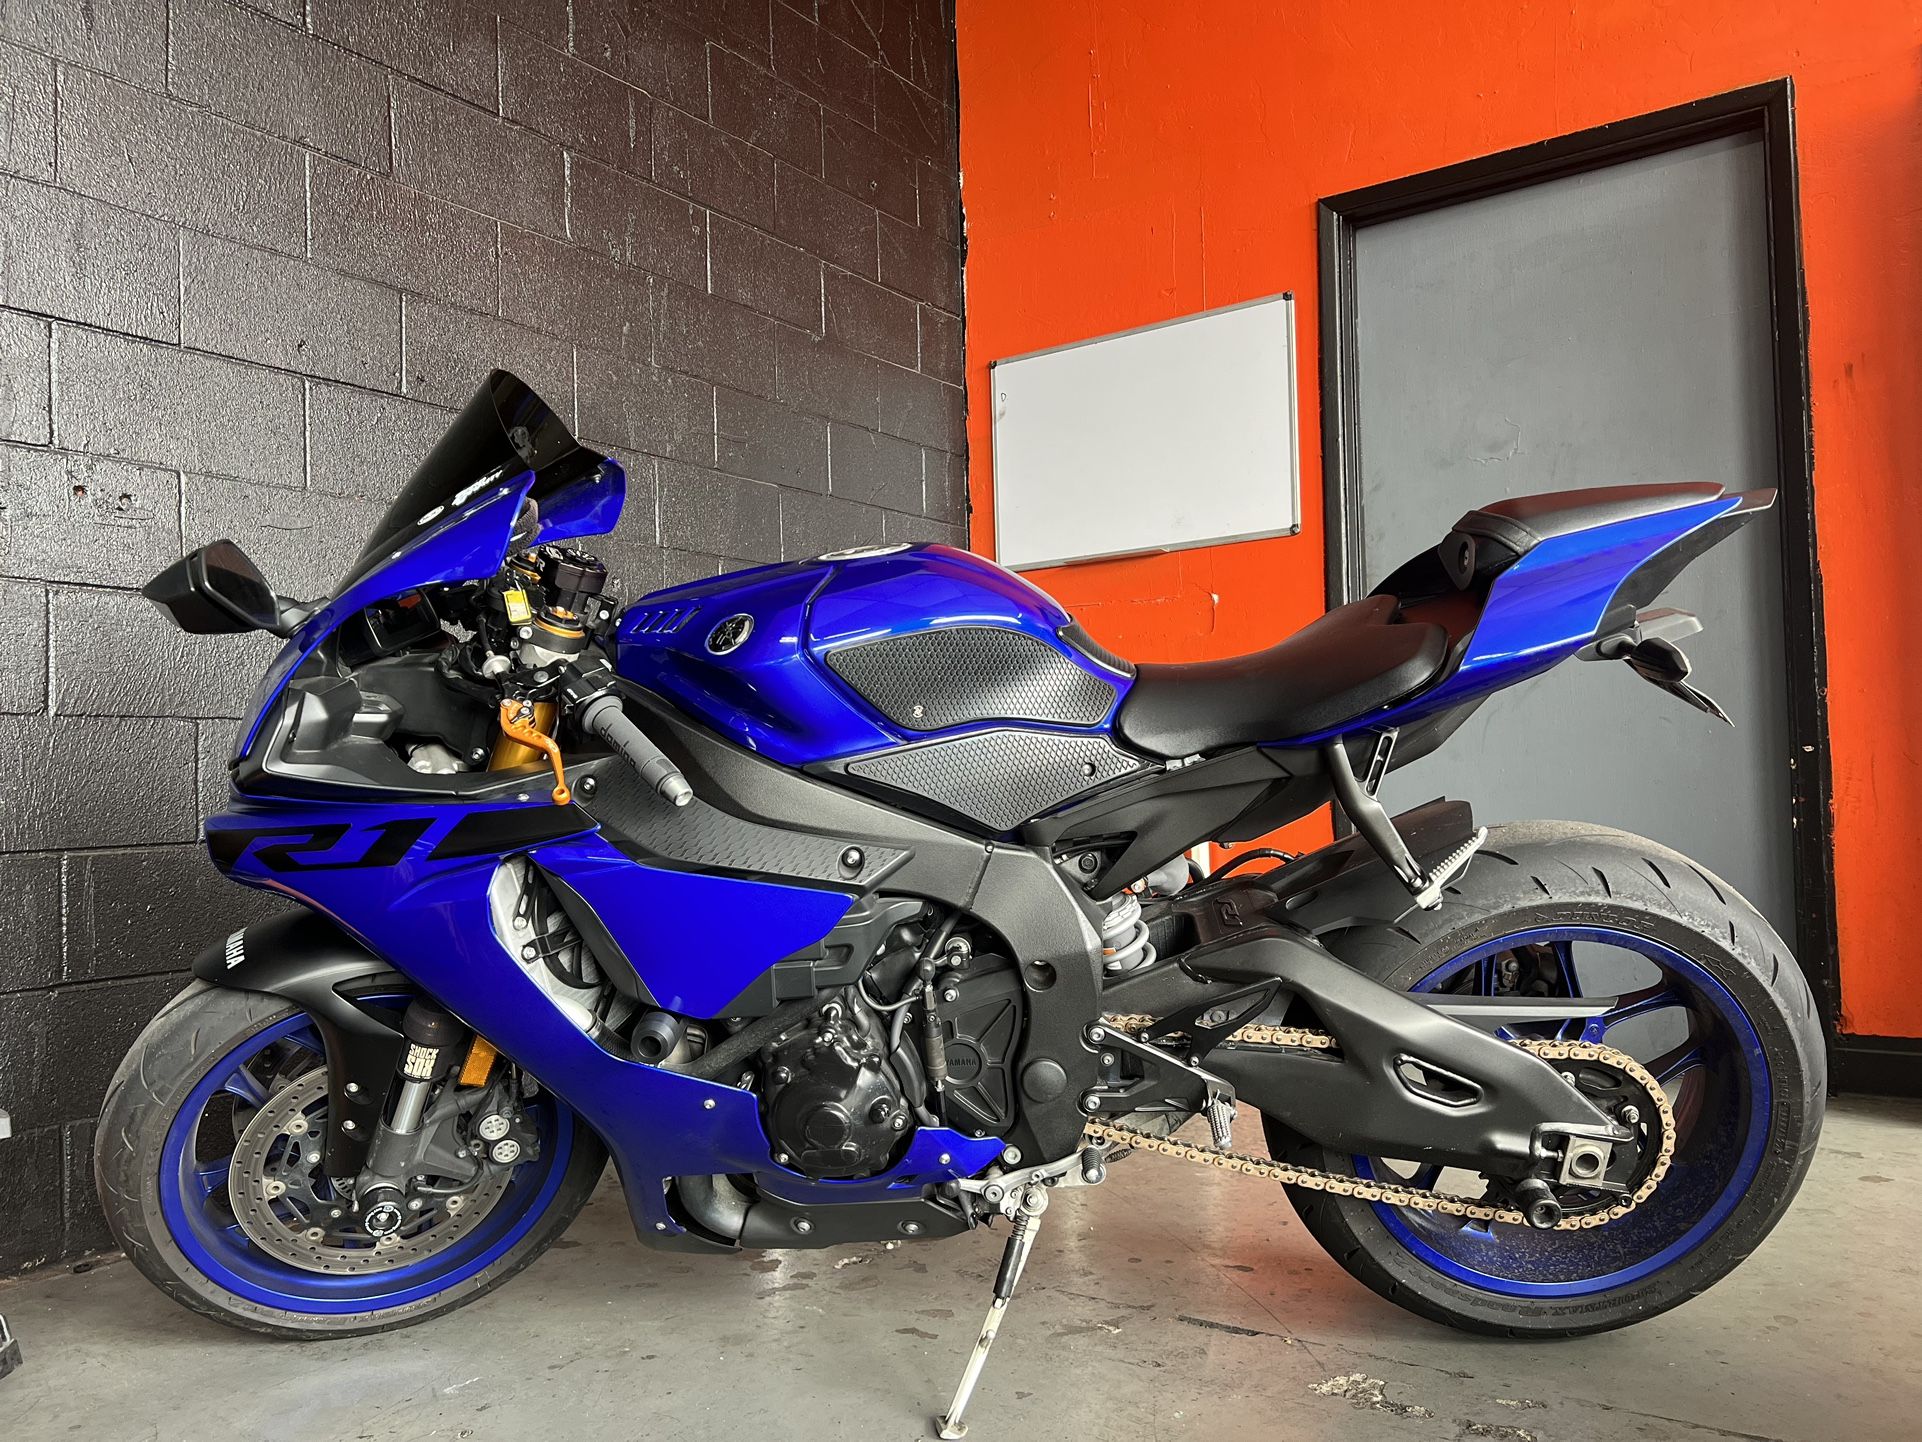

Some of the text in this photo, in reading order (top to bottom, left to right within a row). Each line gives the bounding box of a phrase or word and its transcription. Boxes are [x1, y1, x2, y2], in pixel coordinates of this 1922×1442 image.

[599, 723, 637, 769] domino
[409, 1043, 440, 1060] SHOCK
[403, 1054, 436, 1077] SOX
